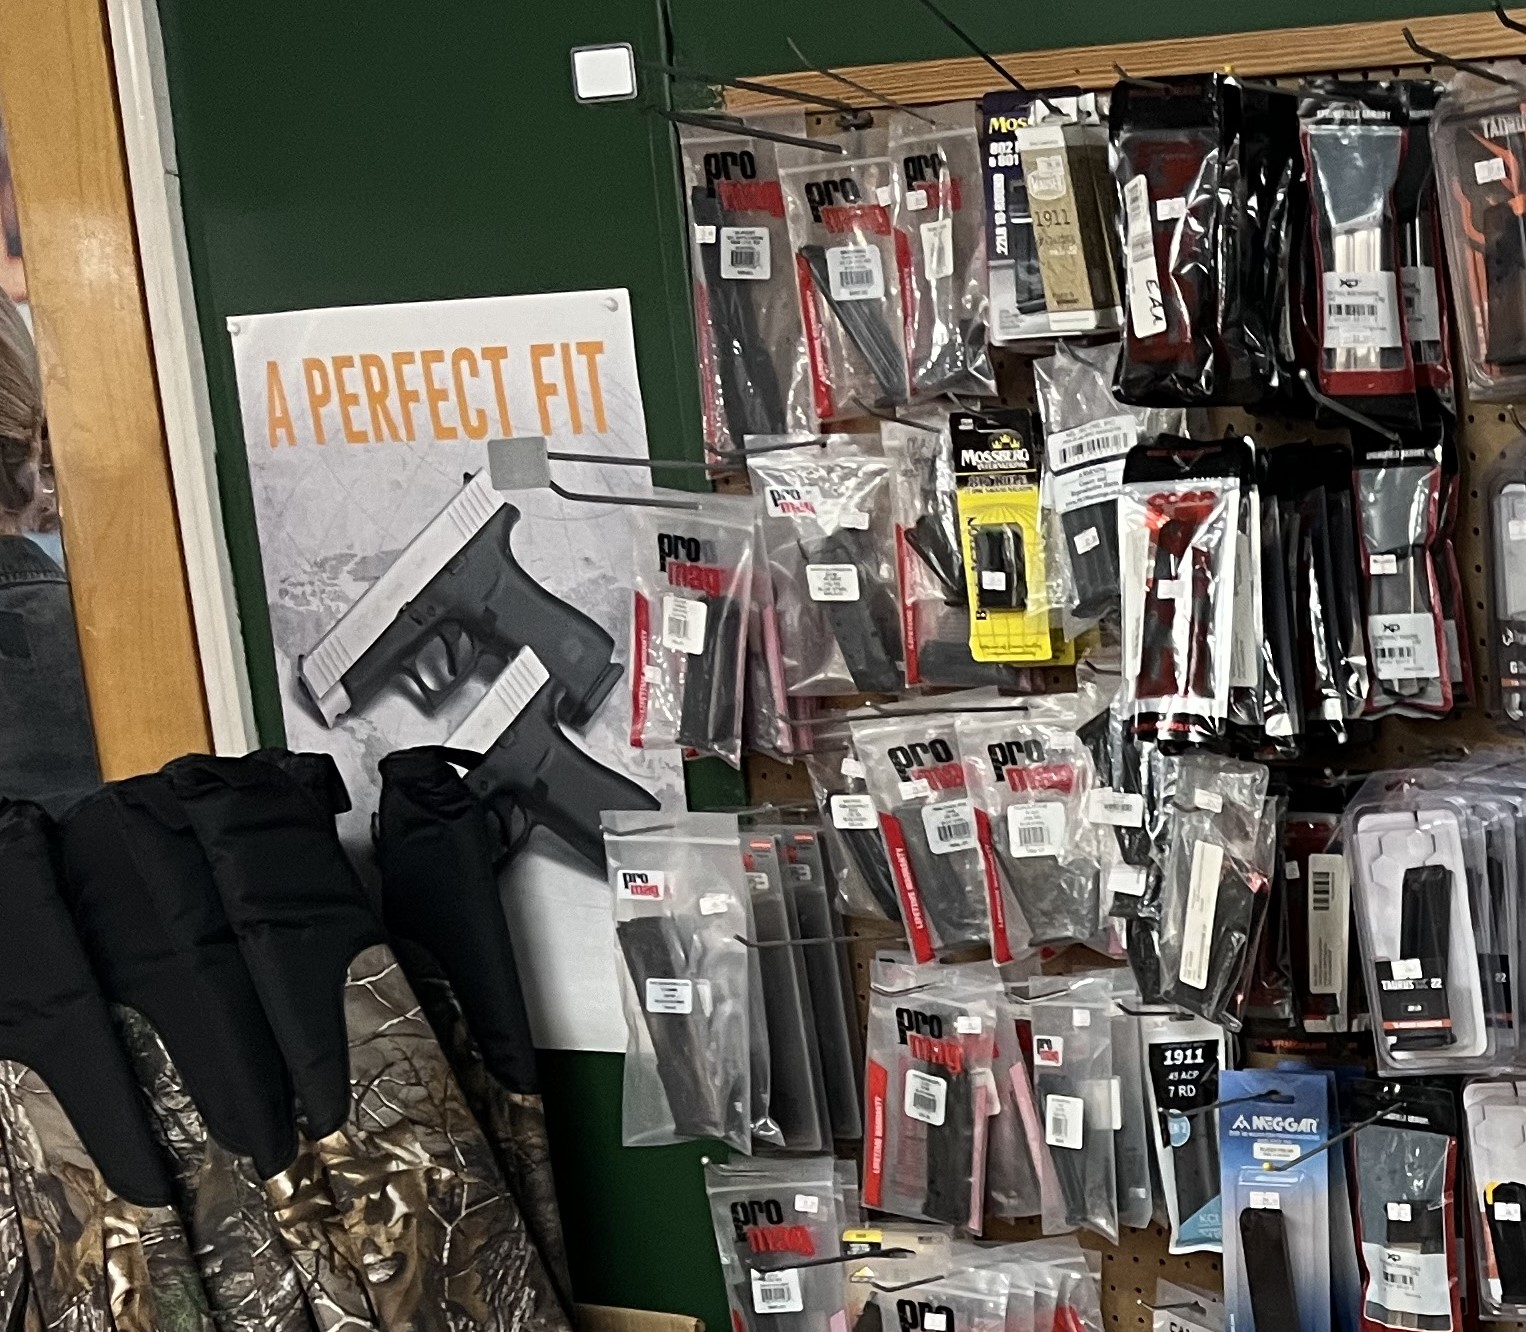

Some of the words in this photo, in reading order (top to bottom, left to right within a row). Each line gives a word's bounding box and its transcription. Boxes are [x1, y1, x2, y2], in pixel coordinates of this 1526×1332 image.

[1034, 210, 1071, 228] 1911
[266, 361, 298, 448] A
[303, 345, 515, 445] PERFECT
[529, 340, 609, 437] FIT
[961, 447, 1030, 468] MOSSBERG
[887, 739, 955, 784] pro
[987, 739, 1047, 782] pro
[622, 872, 649, 892] pro
[630, 884, 660, 899] mag
[895, 1007, 943, 1046] pro
[908, 1034, 964, 1074] mag
[1163, 1048, 1205, 1066] 1911
[1178, 1085, 1197, 1098] RD
[731, 1200, 783, 1242] pro
